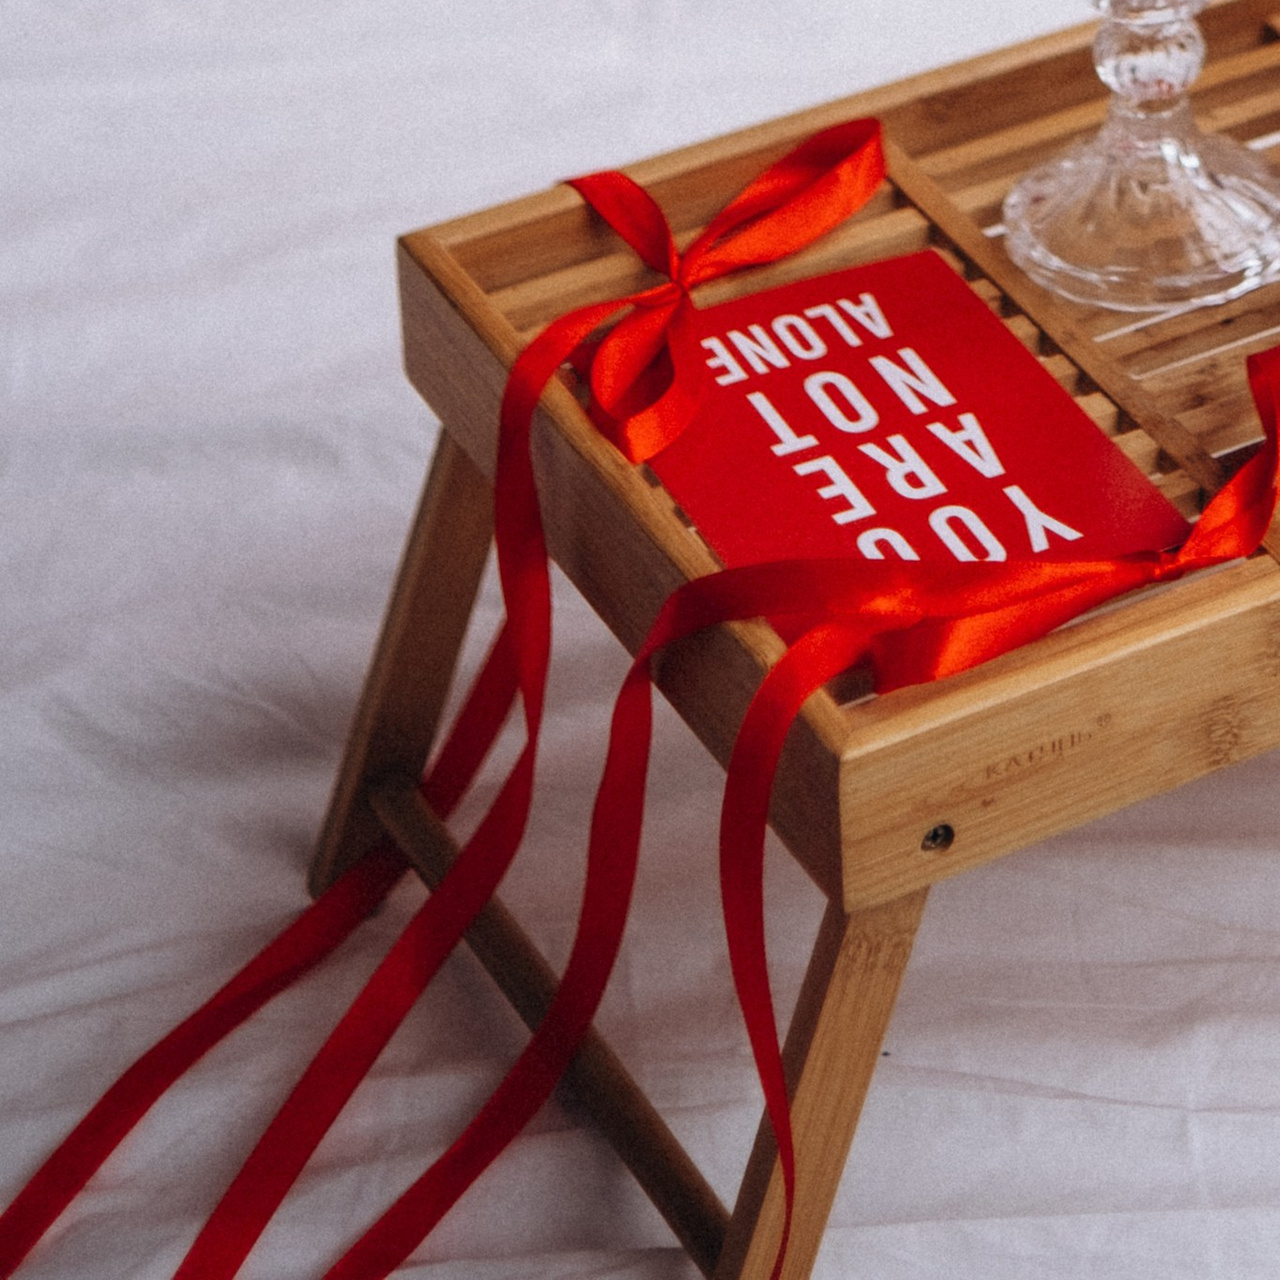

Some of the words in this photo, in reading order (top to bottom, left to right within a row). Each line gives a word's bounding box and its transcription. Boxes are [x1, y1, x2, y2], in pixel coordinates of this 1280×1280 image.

[700, 292, 893, 386] ALONE
[746, 347, 957, 457] NOT
[792, 412, 1006, 526] ARE
